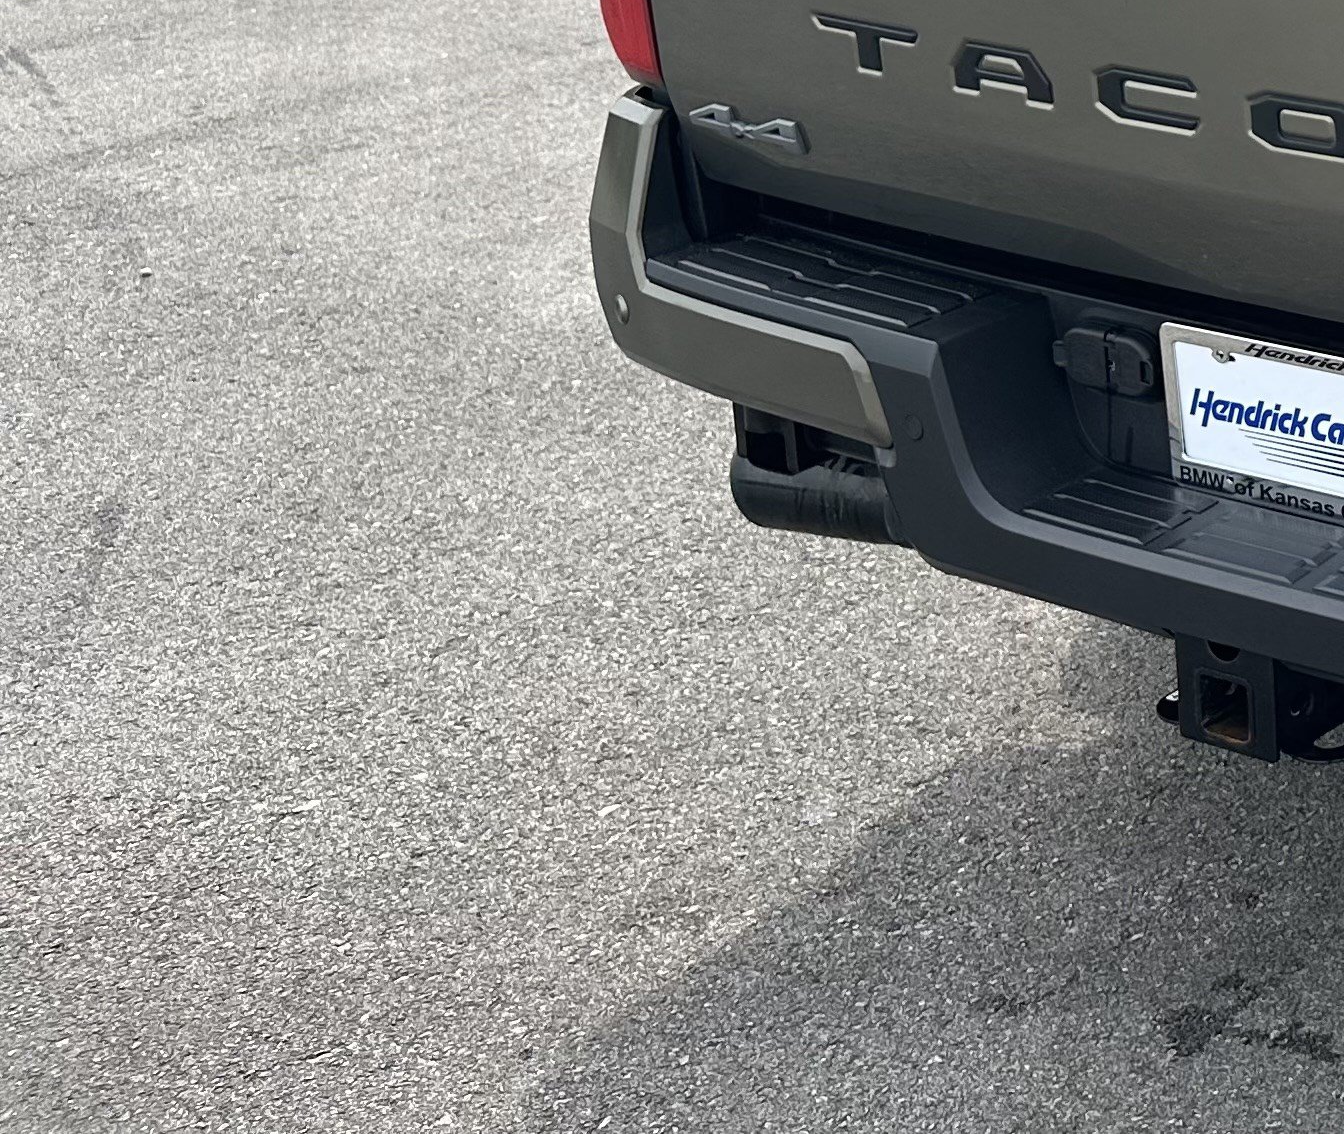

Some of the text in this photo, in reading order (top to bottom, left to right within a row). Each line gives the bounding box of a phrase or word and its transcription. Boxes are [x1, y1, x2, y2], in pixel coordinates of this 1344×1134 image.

[1179, 465, 1225, 489] BMW
[1234, 476, 1255, 496] of
[1260, 483, 1335, 517] Kansas
